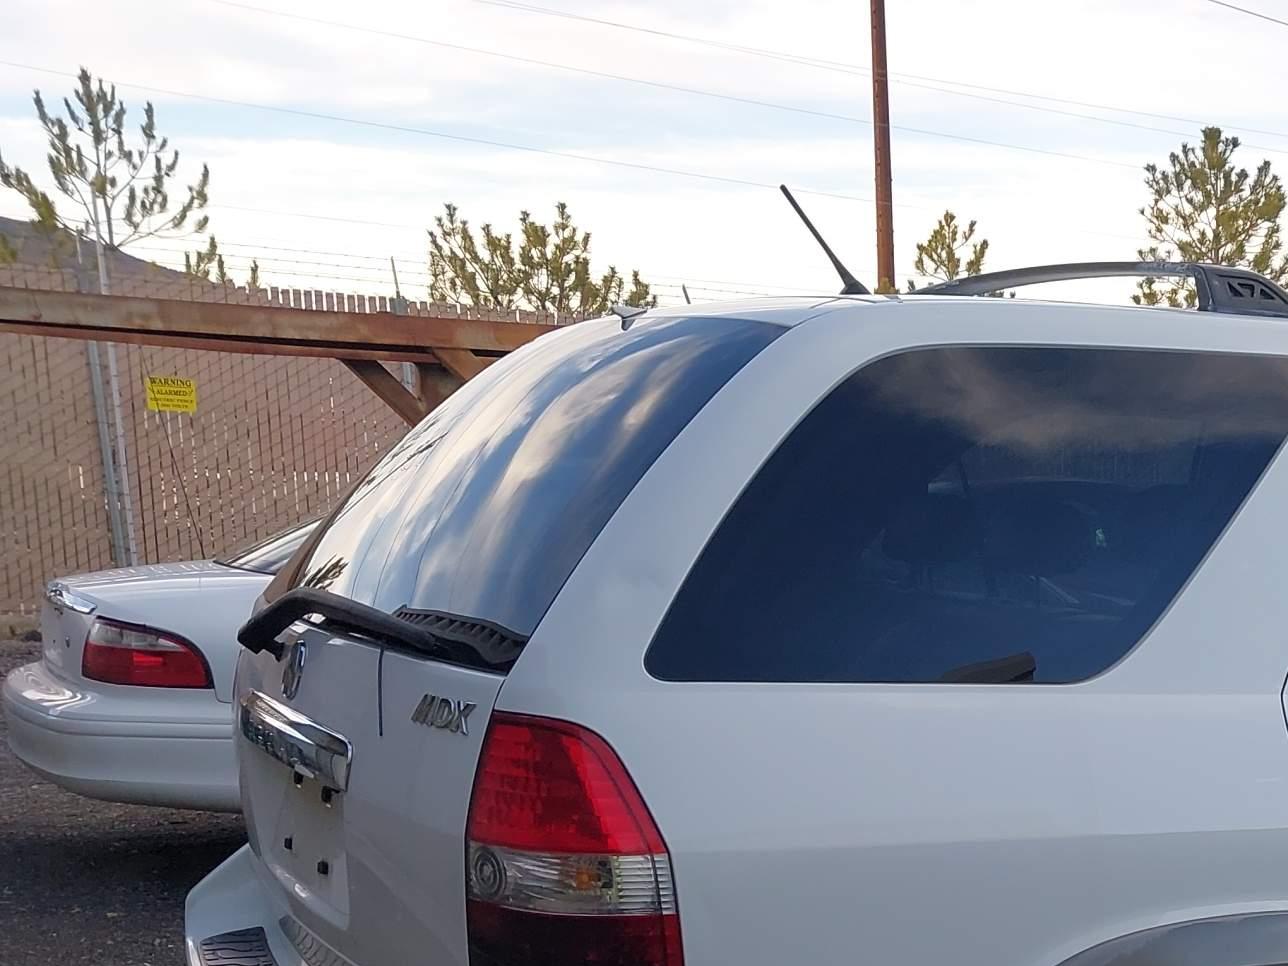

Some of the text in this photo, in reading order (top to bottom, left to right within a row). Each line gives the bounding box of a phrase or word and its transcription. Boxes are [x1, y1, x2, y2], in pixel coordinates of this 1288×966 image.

[149, 376, 192, 387] WARNING
[156, 388, 188, 397] ALARMED
[411, 693, 477, 736] MDX
